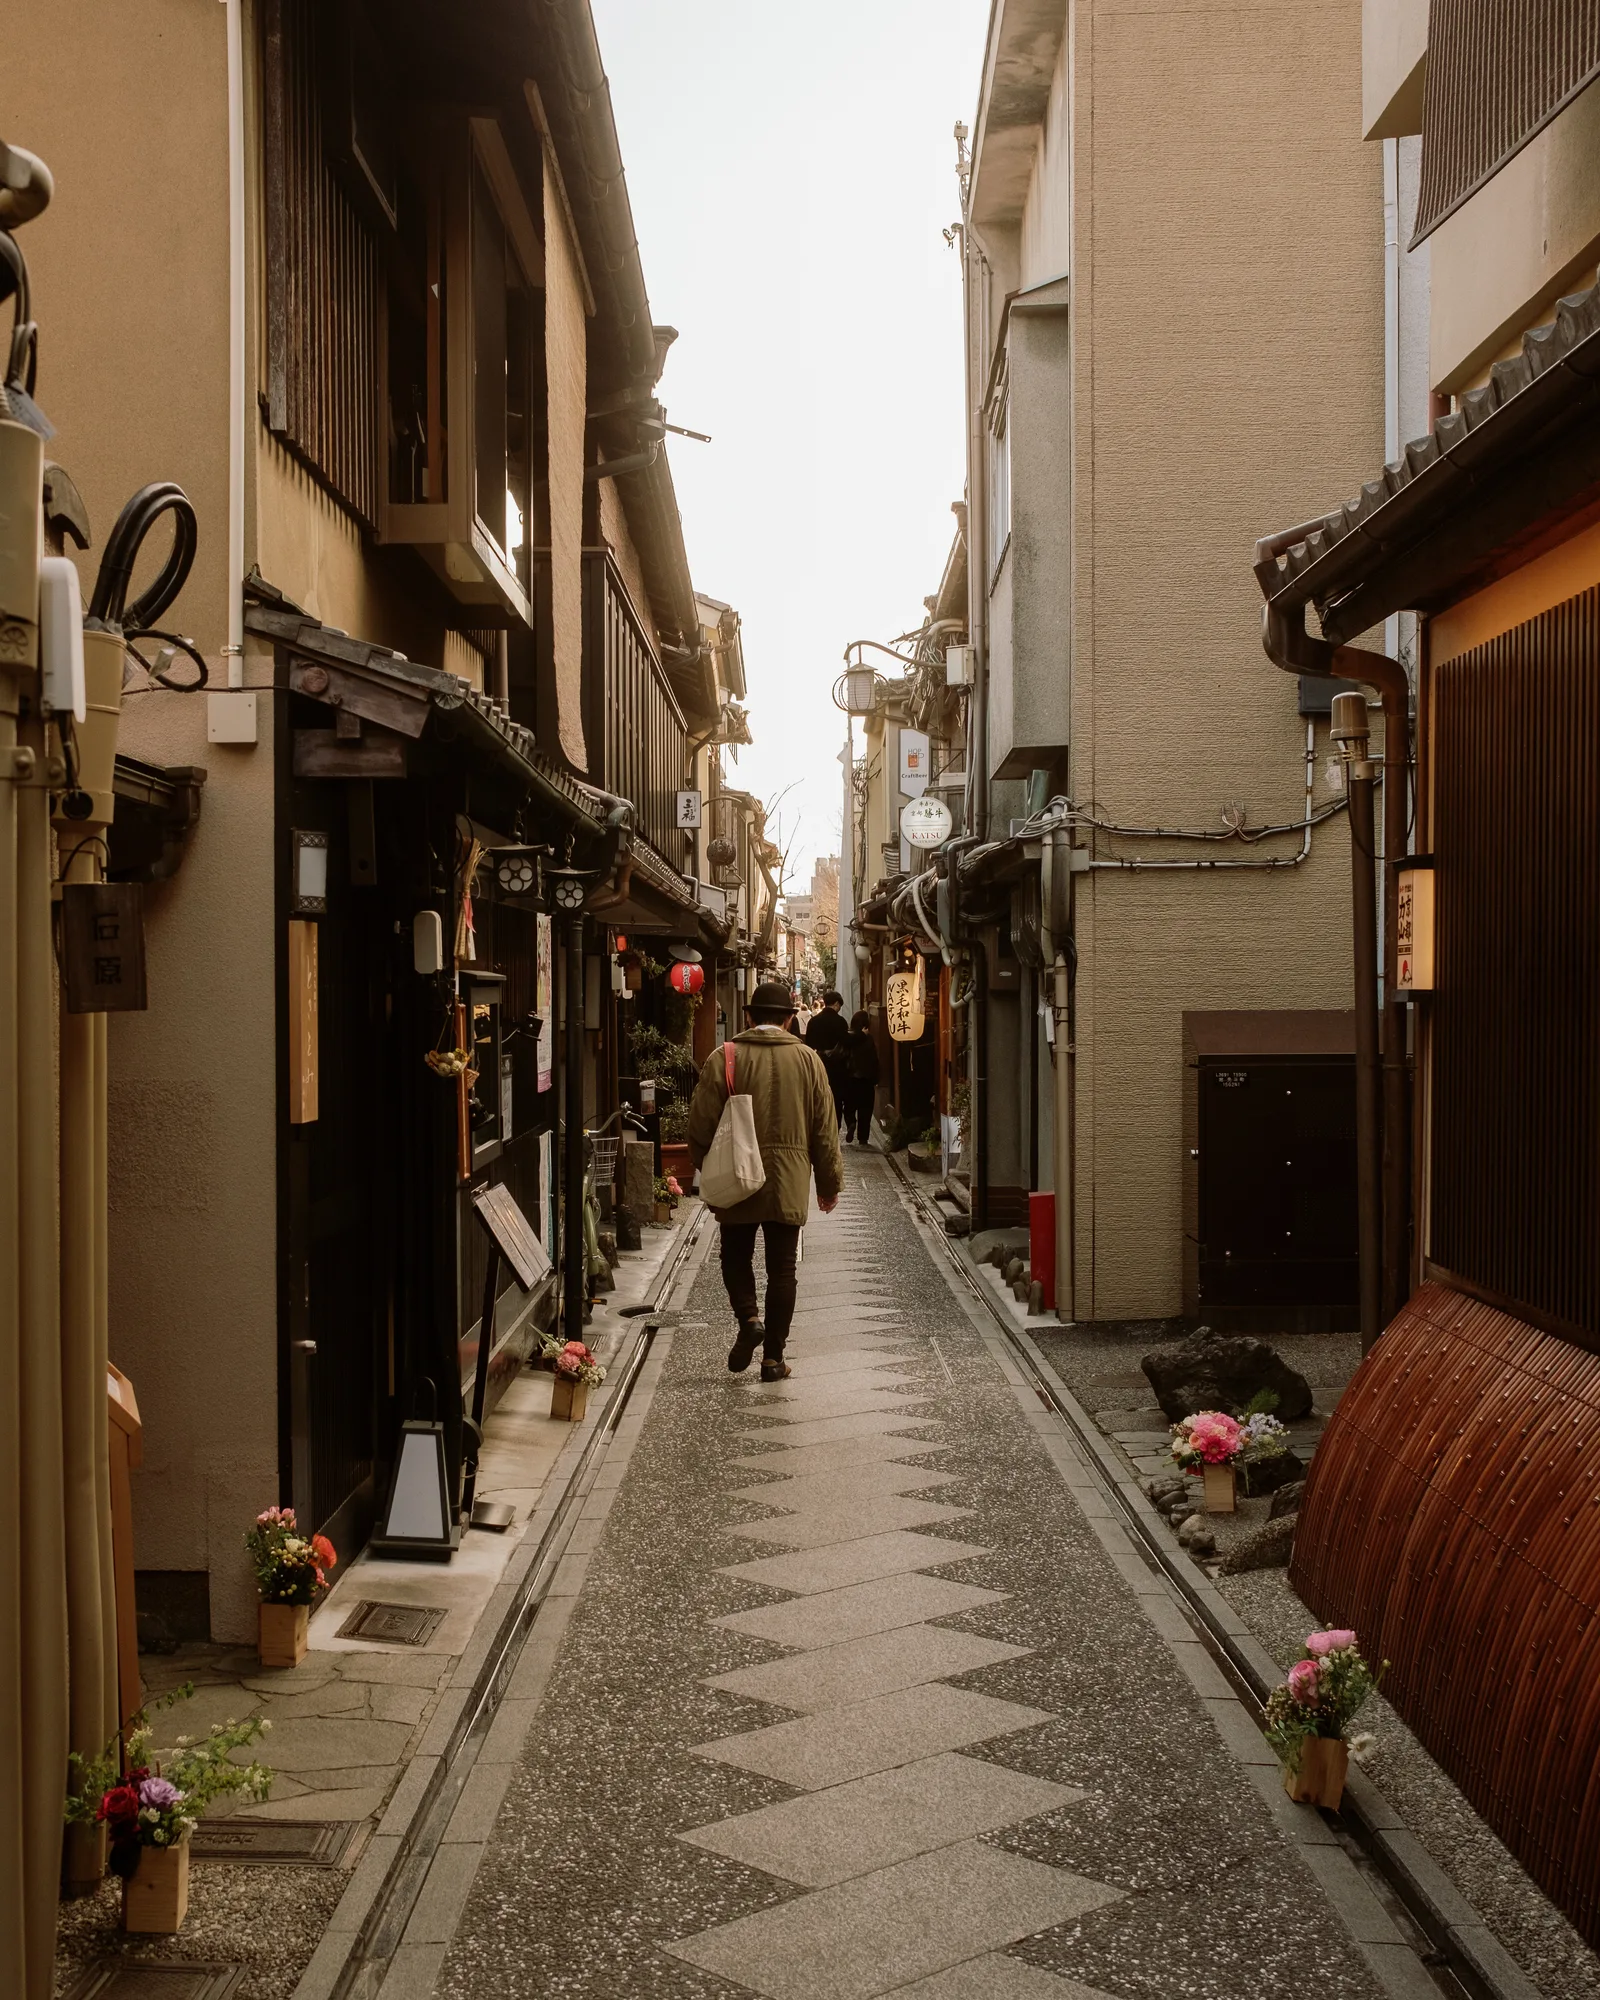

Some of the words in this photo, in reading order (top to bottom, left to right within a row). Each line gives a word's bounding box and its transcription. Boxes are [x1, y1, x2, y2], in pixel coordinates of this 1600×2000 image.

[92, 912, 122, 986] 石原
[887, 982, 896, 1034] WAGYU
[896, 979, 912, 1036] 黒毛和牛
